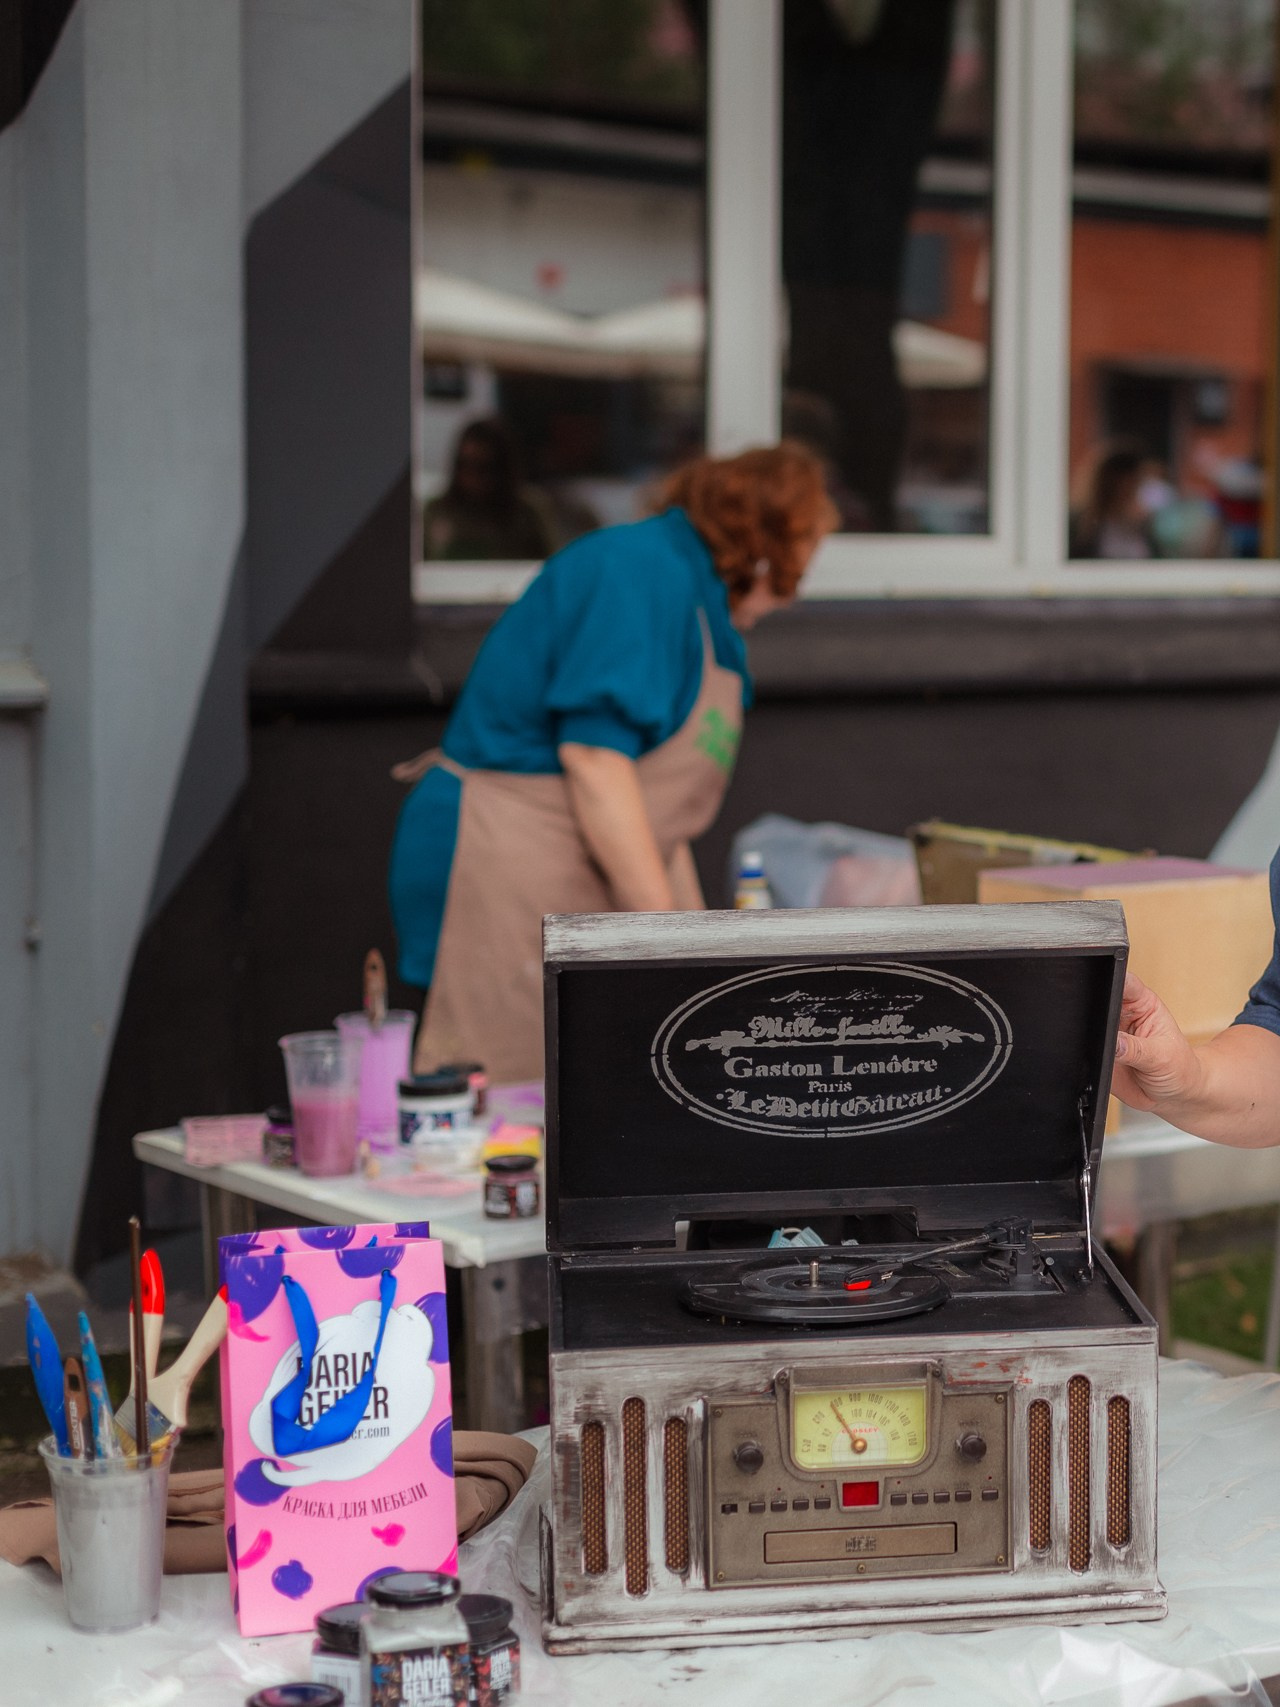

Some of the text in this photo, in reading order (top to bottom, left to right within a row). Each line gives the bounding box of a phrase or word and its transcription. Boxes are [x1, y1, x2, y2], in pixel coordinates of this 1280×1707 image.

[724, 1055, 938, 1078] Gaston Lenôtre
[807, 1080, 853, 1094] Paris
[282, 1482, 429, 1520] КРАСКА ДЛЯ МЕБЕЛИ
[401, 1654, 451, 1681] DARIA
[402, 1677, 452, 1701] GEILER
